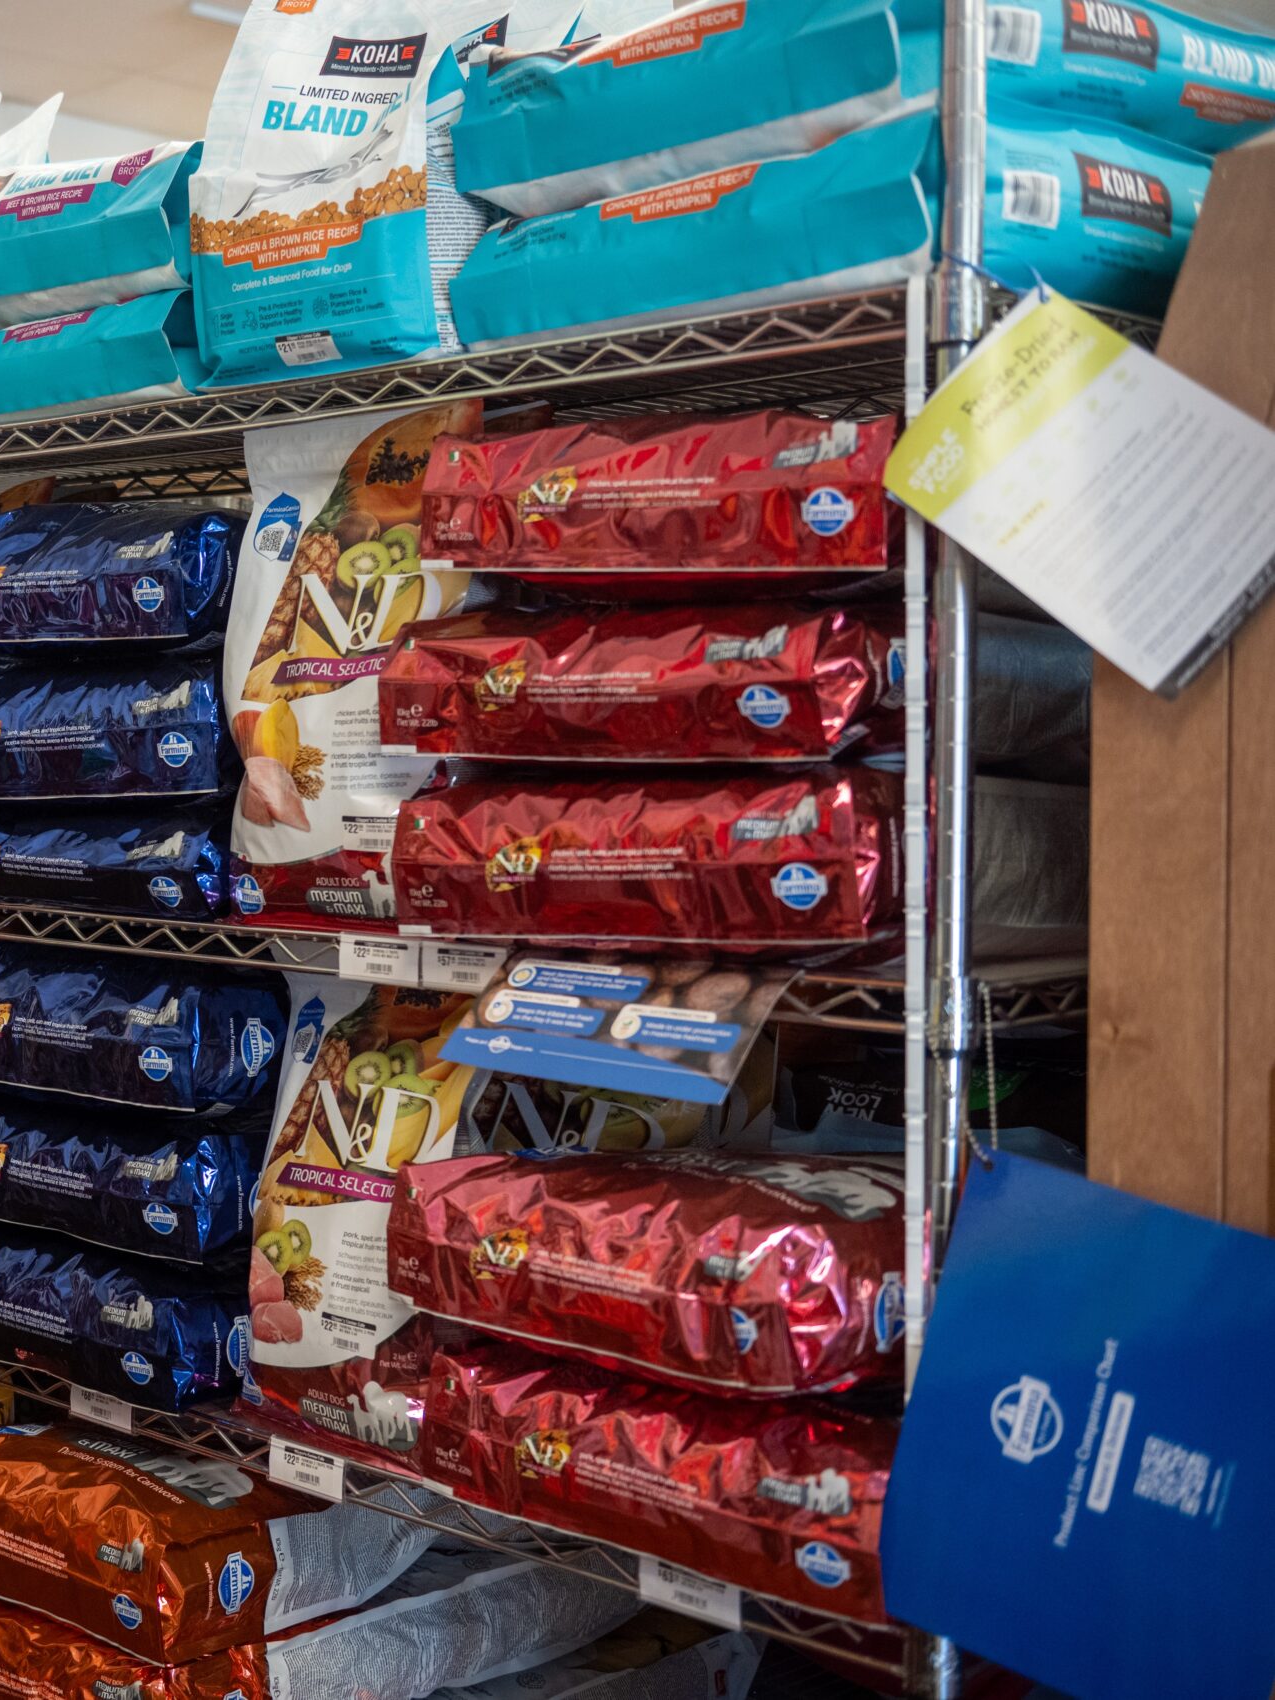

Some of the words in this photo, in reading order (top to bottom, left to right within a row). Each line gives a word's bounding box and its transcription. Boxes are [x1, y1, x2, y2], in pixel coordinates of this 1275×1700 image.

[673, 17, 697, 32] RICE
[699, 8, 738, 27] RECIPE
[1084, 0, 1137, 38] KOHA
[350, 45, 398, 64] KOHA
[619, 45, 644, 60] WITH
[645, 33, 694, 54] PUMPKIN
[1182, 33, 1254, 82] BLAND
[299, 85, 348, 101] LIMITED
[262, 101, 369, 137] BLAND
[121, 156, 146, 166] BONE
[693, 177, 715, 191] RICE
[717, 168, 750, 185] RECIPE
[1099, 165, 1151, 204] KOHA
[46, 192, 60, 201] RICE
[60, 188, 84, 199] RECIPE
[640, 202, 664, 216] WITH
[665, 193, 711, 212] PUMPKIN
[21, 207, 35, 217] WITH
[35, 202, 61, 214] PUMPKIN
[227, 242, 259, 258] CHICKEN
[268, 236, 302, 250] BROWN
[303, 230, 325, 241] RICE
[327, 225, 359, 240] RECIPE
[258, 252, 279, 264] WITH
[280, 245, 320, 262] PUMPKIN
[232, 279, 261, 292] Complete
[269, 272, 300, 285] Balanced
[301, 268, 320, 279] Food
[321, 265, 332, 275] for
[333, 263, 352, 275] Dogs
[135, 590, 162, 599] Farmina
[286, 659, 333, 678] TROPICAL
[161, 744, 189, 755] Farmina
[315, 877, 339, 887] ADULT
[341, 876, 360, 887] DOG
[774, 881, 825, 894] Farmina
[310, 889, 363, 904] MEDIUM
[334, 903, 366, 916] MAXI
[250, 1025, 261, 1076] Farmina
[143, 1060, 170, 1071] Farmina
[828, 1087, 881, 1108] LOOK
[293, 1080, 441, 1172] N&D
[289, 1167, 335, 1188] TROPICAL
[146, 1214, 177, 1226] Farmina
[343, 1231, 359, 1240] pork,
[237, 1317, 249, 1375] Farmina
[307, 1388, 327, 1402] ADULT
[328, 1394, 345, 1408] DOG
[303, 1399, 348, 1424] MEDIUM
[1076, 1381, 1108, 1462] Comparison
[323, 1418, 351, 1437] MAXI
[89, 1440, 138, 1459] MAXI
[57, 1446, 95, 1463] Nutrition
[93, 1457, 125, 1471] System
[123, 1467, 138, 1478] for
[136, 1475, 186, 1505] Carnivores
[226, 1554, 244, 1612] Farmina
